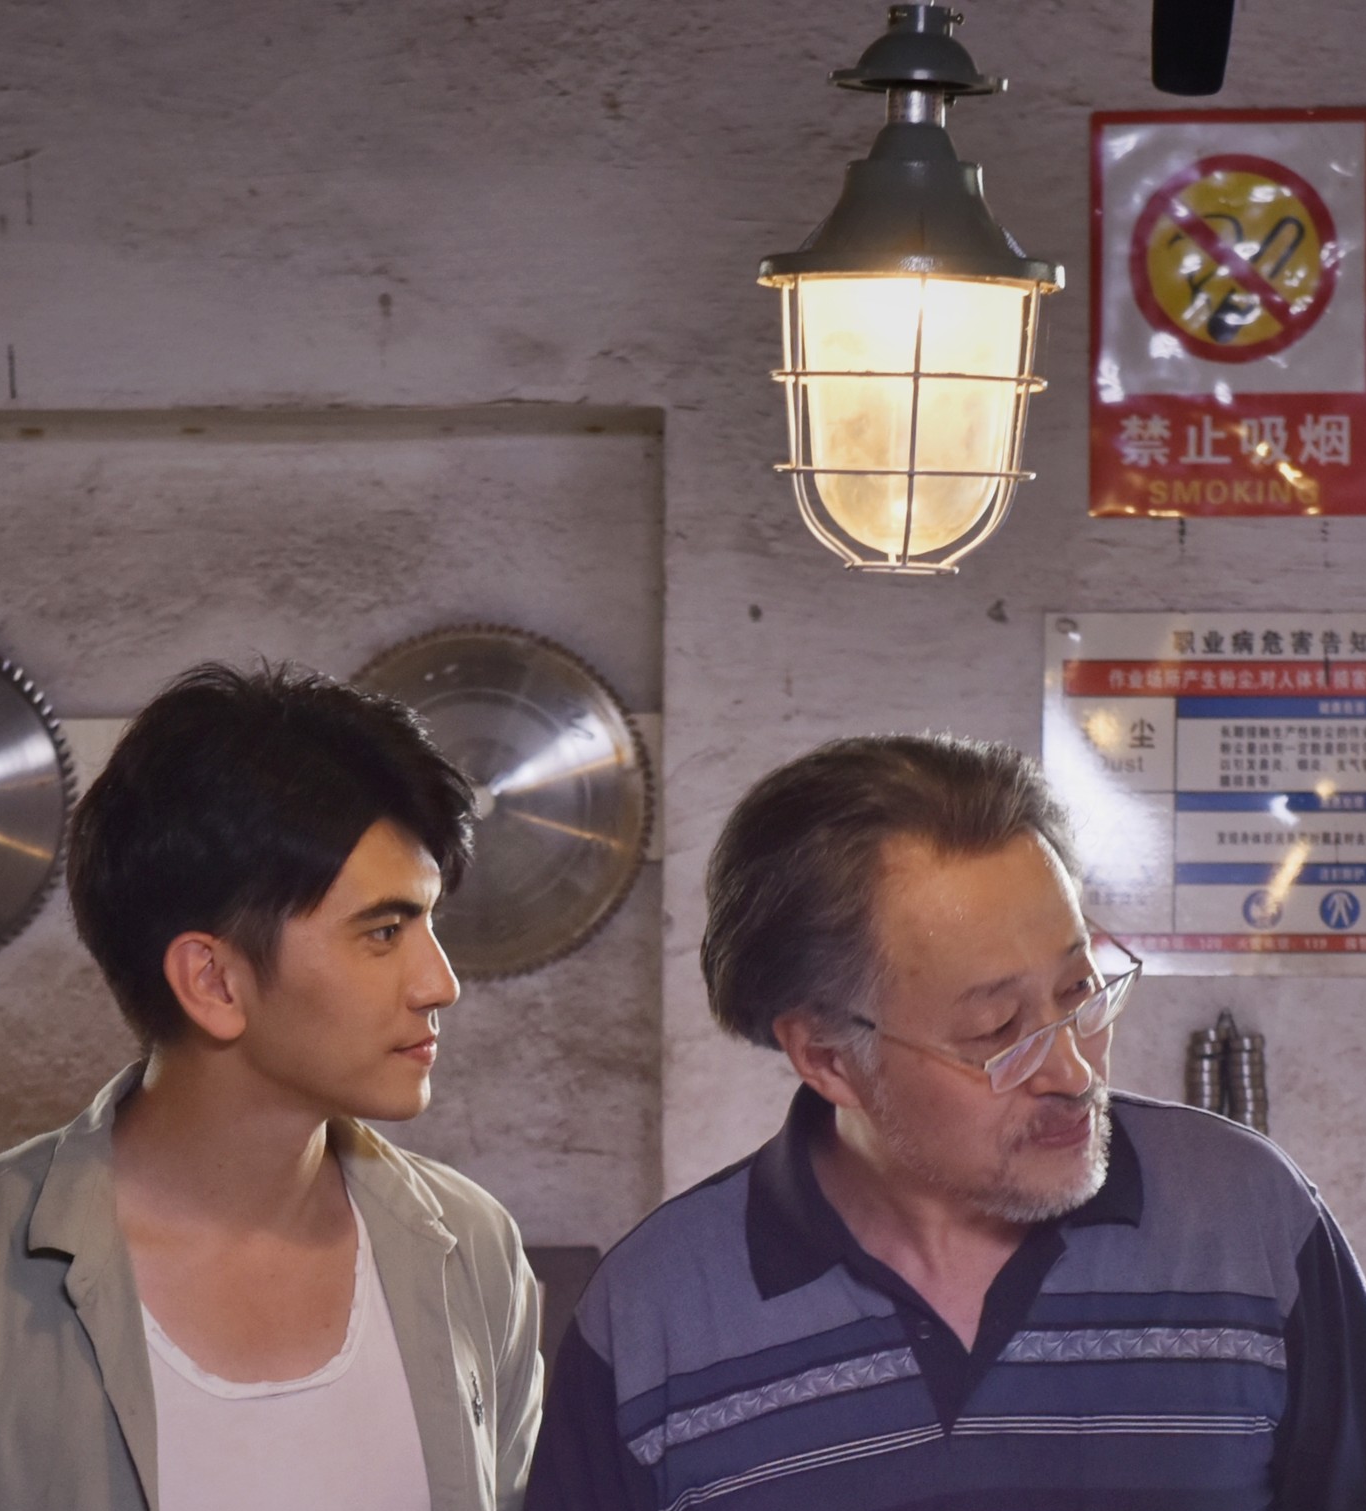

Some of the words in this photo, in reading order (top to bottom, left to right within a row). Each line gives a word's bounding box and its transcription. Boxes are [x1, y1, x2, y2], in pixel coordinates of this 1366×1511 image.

[1120, 414, 1352, 466] 禁止吸烟
[1148, 480, 1321, 504] SMOKING
